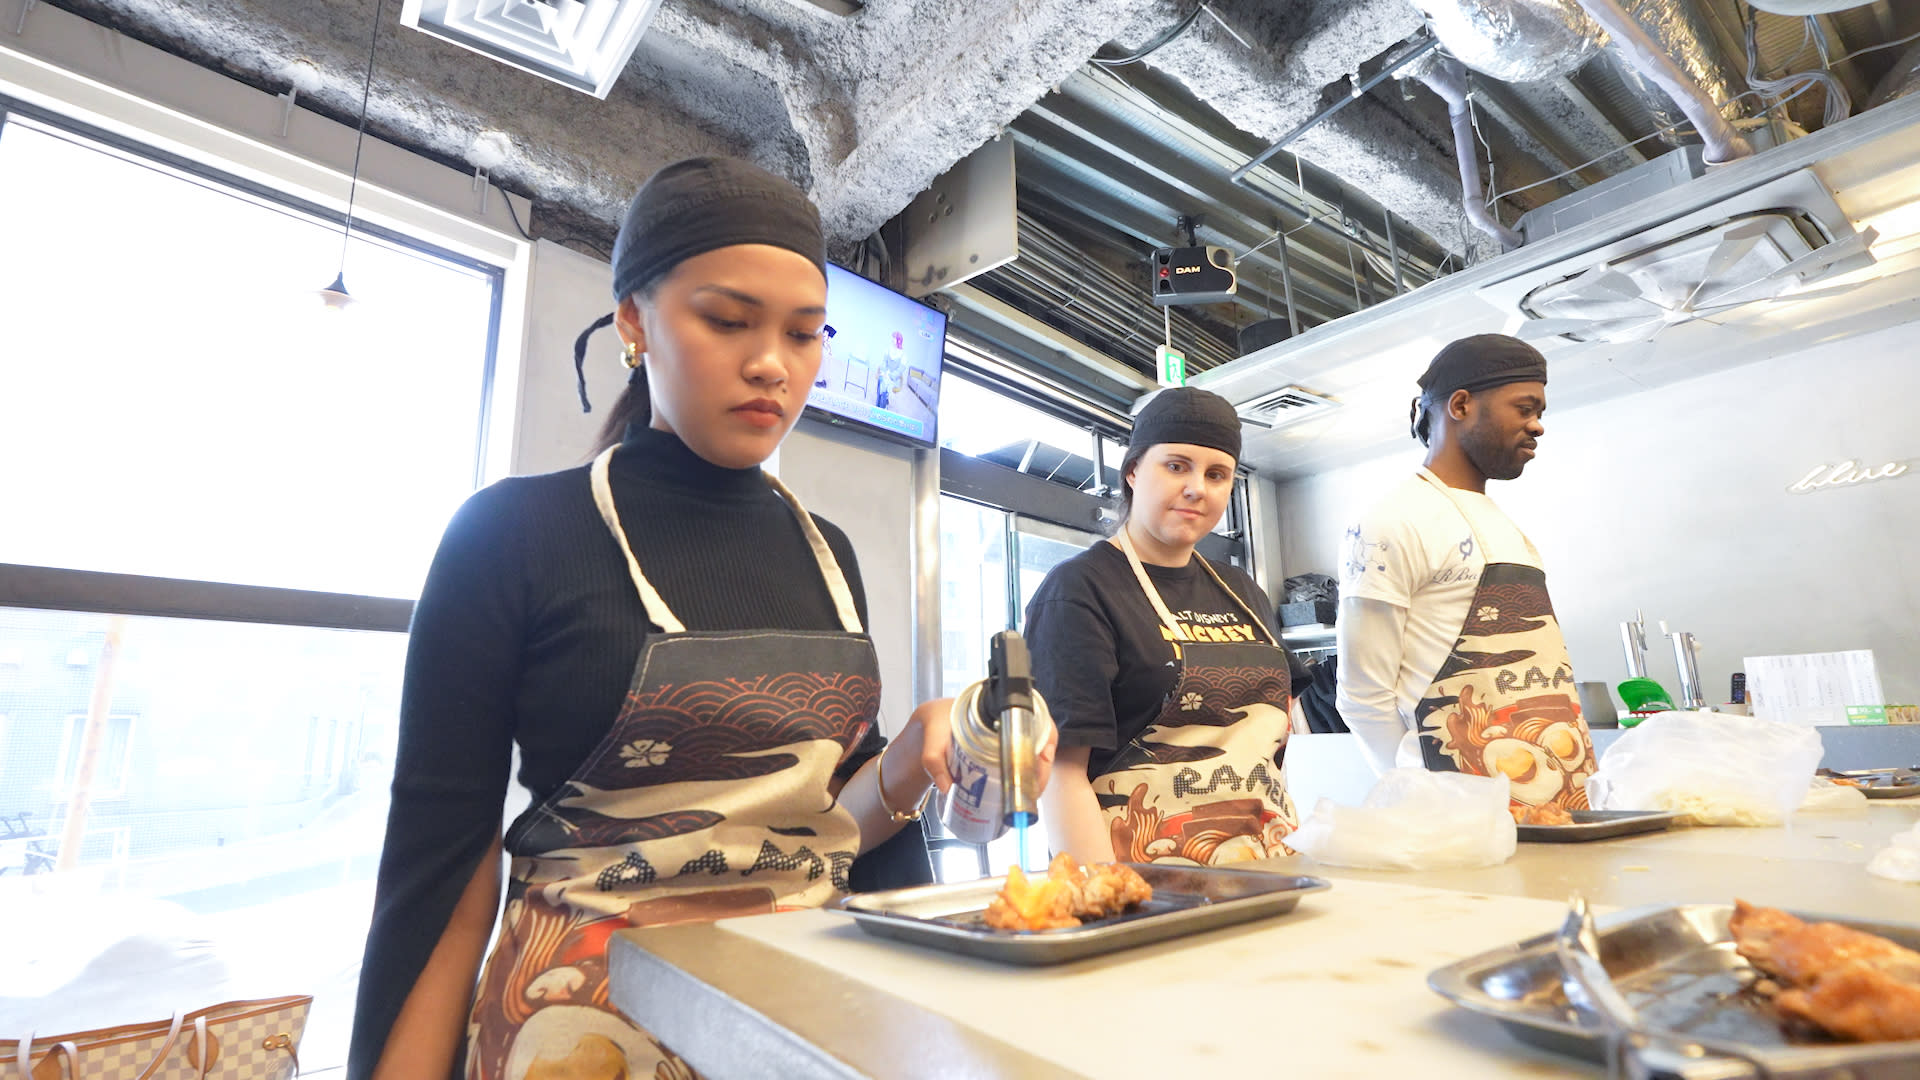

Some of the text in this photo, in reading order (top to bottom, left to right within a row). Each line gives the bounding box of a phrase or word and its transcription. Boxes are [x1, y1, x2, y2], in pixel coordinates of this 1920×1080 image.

[1175, 266, 1201, 275] DAM
[1171, 610, 1239, 625] ALT DISNEY'S
[1495, 666, 1575, 695] RAM
